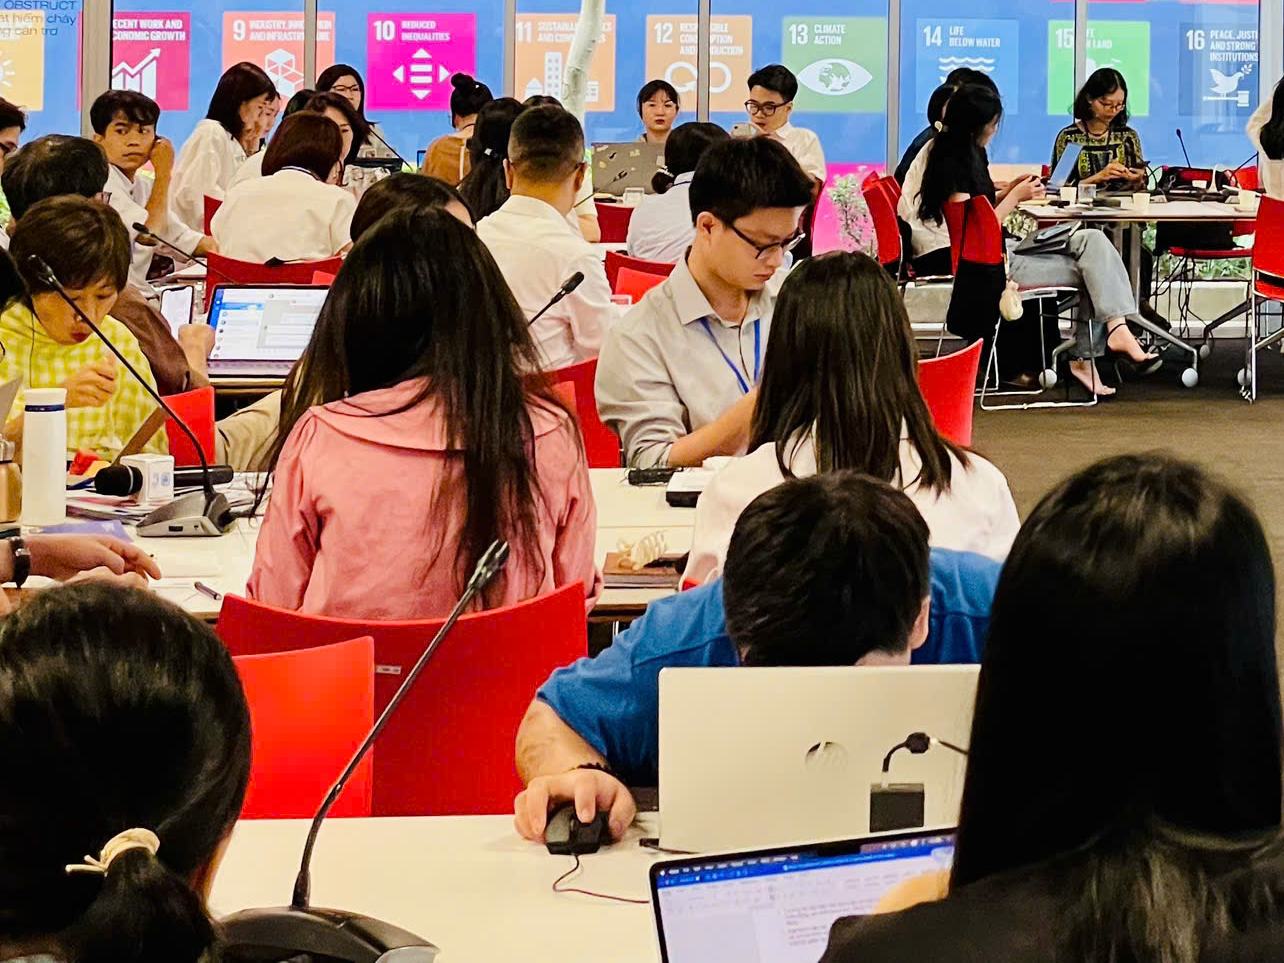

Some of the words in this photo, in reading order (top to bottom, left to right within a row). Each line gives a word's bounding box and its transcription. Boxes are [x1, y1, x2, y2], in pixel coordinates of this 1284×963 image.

[4, 0, 77, 10] OBSTRUCT
[113, 19, 138, 30] ECENT
[140, 19, 163, 30] WORK
[165, 19, 183, 30] AND
[233, 19, 246, 41] 9
[814, 25, 846, 35] CLIMATE
[113, 31, 150, 41] CONOMIC
[151, 31, 186, 41] GROWTH
[373, 20, 395, 41] 10
[516, 20, 532, 43] 11
[654, 22, 673, 44] 12
[788, 24, 808, 45] 13
[950, 26, 964, 36] LIFE
[1211, 30, 1234, 40] PEACE,
[1237, 30, 1258, 40] JUSTI
[814, 36, 842, 46] ACTION
[923, 26, 943, 47] 14
[1055, 28, 1074, 49] 15
[1186, 30, 1205, 50] 16
[950, 37, 975, 47] BELOW
[976, 37, 1000, 48] WATER
[1211, 42, 1227, 51] AND
[1227, 42, 1256, 51] STRONG
